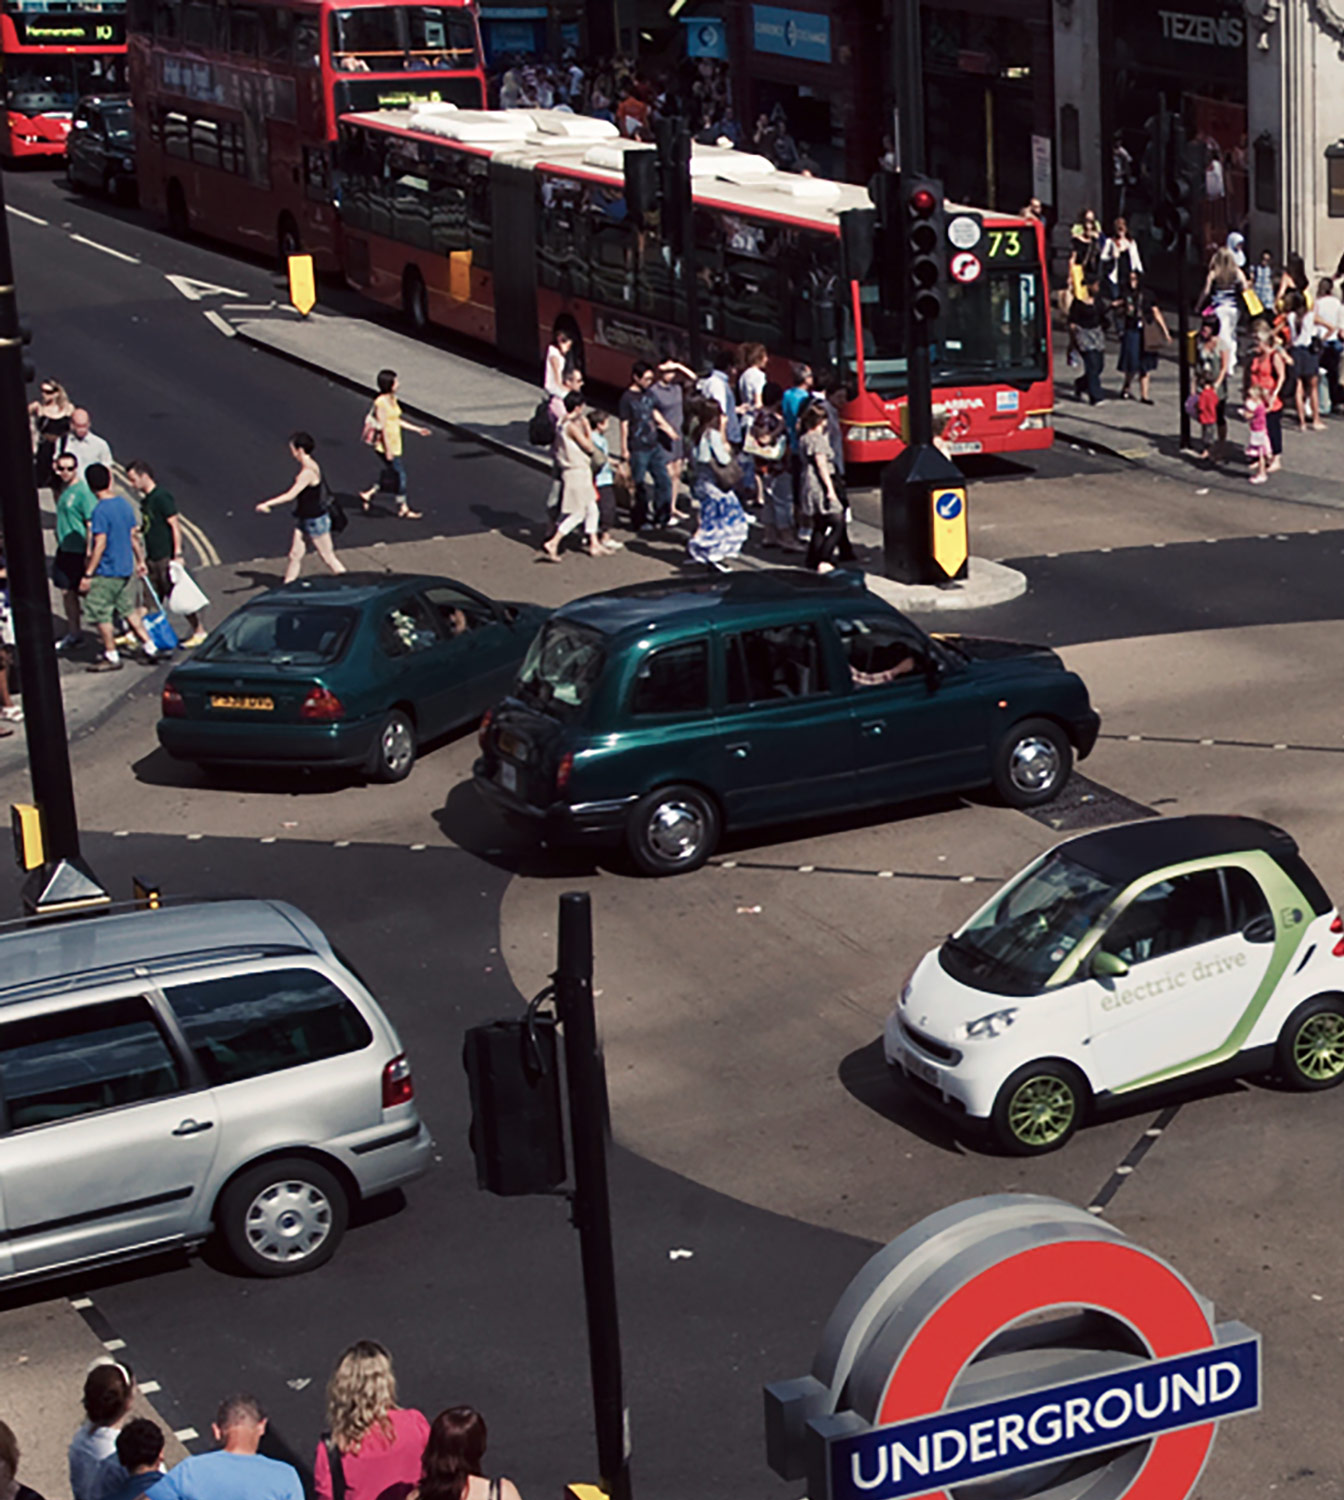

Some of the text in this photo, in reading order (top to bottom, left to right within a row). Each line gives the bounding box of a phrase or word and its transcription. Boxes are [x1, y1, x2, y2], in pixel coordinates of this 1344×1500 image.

[96, 25, 112, 40] 10
[988, 231, 1020, 257] 73
[1100, 951, 1247, 1012] electric drive
[851, 1361, 1242, 1490] UNDERGROUND
